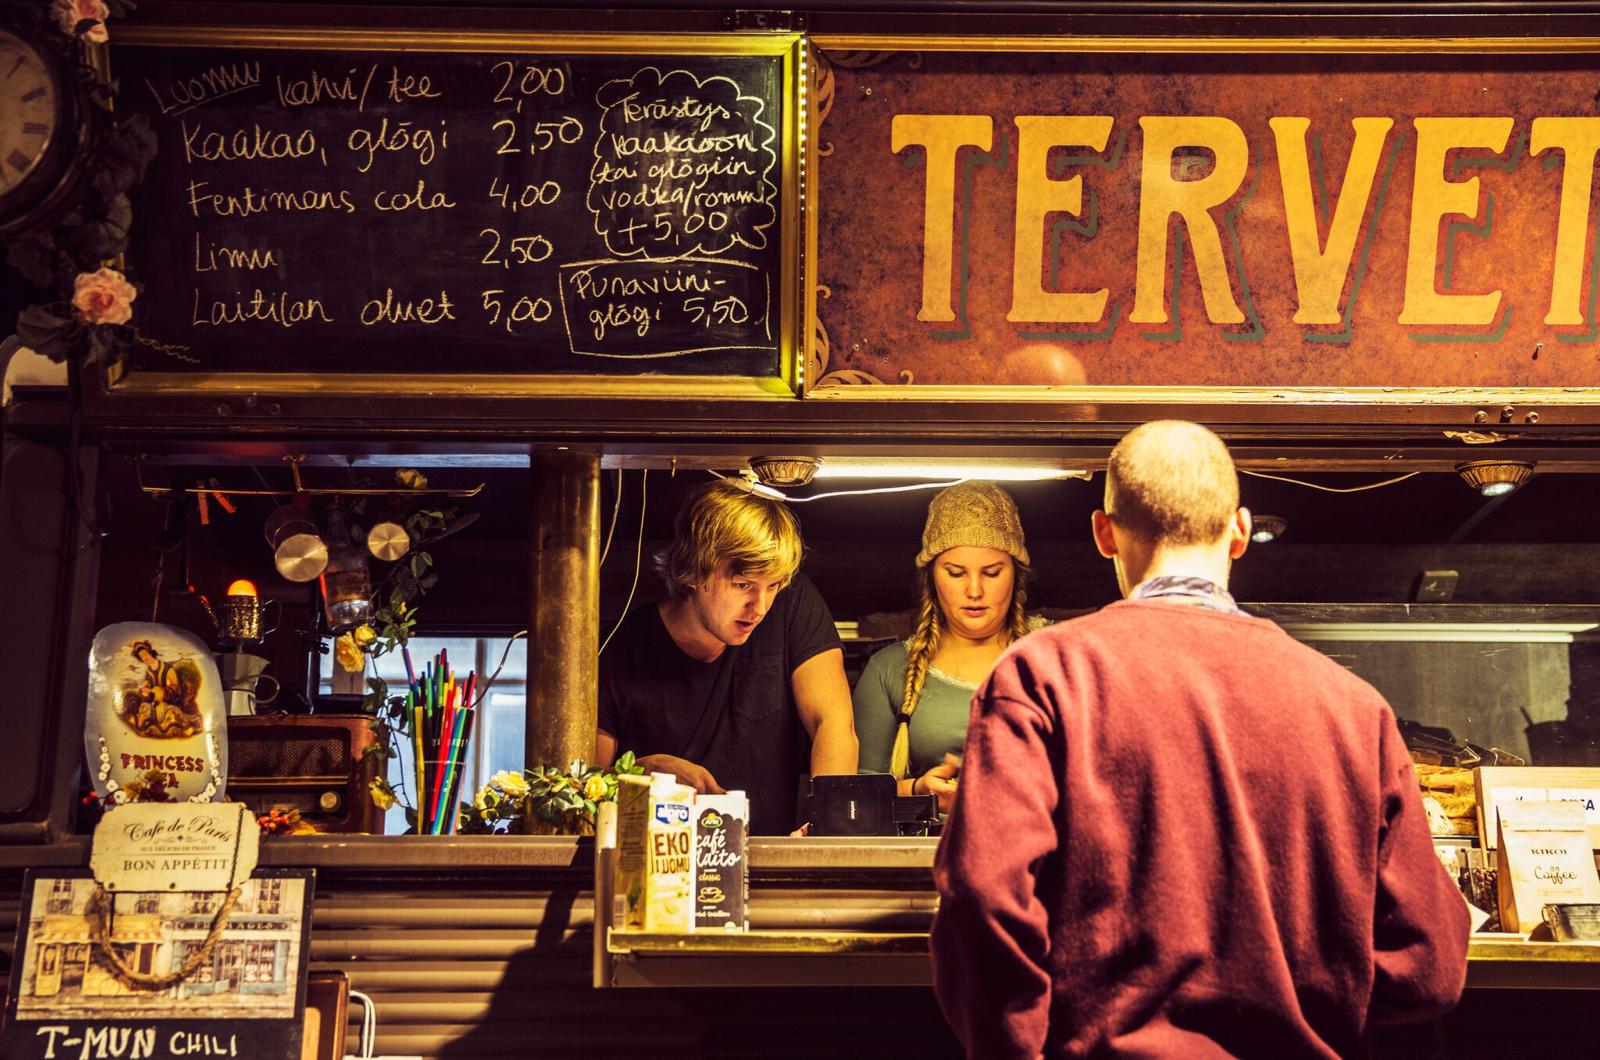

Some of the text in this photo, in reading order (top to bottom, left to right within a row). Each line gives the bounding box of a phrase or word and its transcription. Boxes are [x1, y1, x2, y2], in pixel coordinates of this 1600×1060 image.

[492, 116, 584, 155] 2,50
[186, 177, 561, 217] Fentimans cola 4,00
[891, 114, 1600, 325] TERVET
[196, 228, 553, 271] Limu 2,50
[193, 288, 334, 327] Laitilan
[482, 290, 552, 332] 5,00
[683, 296, 748, 328] 5,50
[120, 753, 205, 773] PRINCESS
[123, 815, 232, 842] Café de Paris
[654, 831, 689, 857] EKO
[123, 857, 229, 871] BON APPÉTIT
[1534, 866, 1577, 884] Coffee
[36, 1025, 238, 1060] T-MUN CHILI
